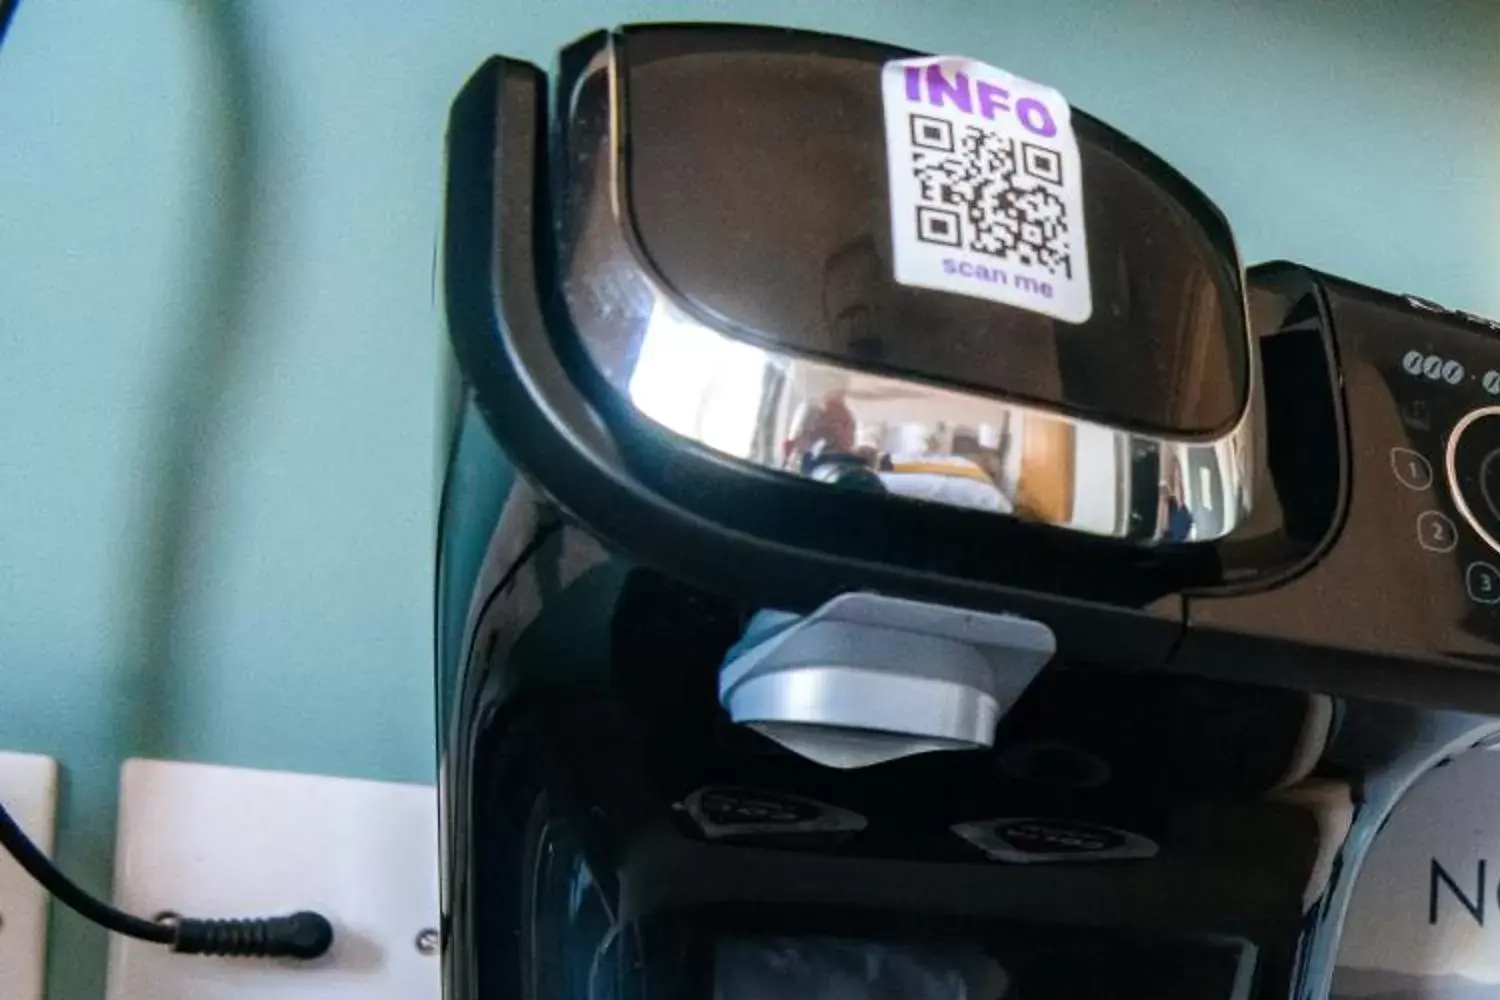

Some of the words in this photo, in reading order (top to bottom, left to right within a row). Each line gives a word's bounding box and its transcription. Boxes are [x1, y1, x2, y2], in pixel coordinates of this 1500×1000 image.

[904, 64, 1058, 139] INFO
[942, 257, 1008, 287] scan
[1014, 274, 1055, 299] me
[1432, 522, 1446, 540] 2
[1480, 575, 1492, 592] 3
